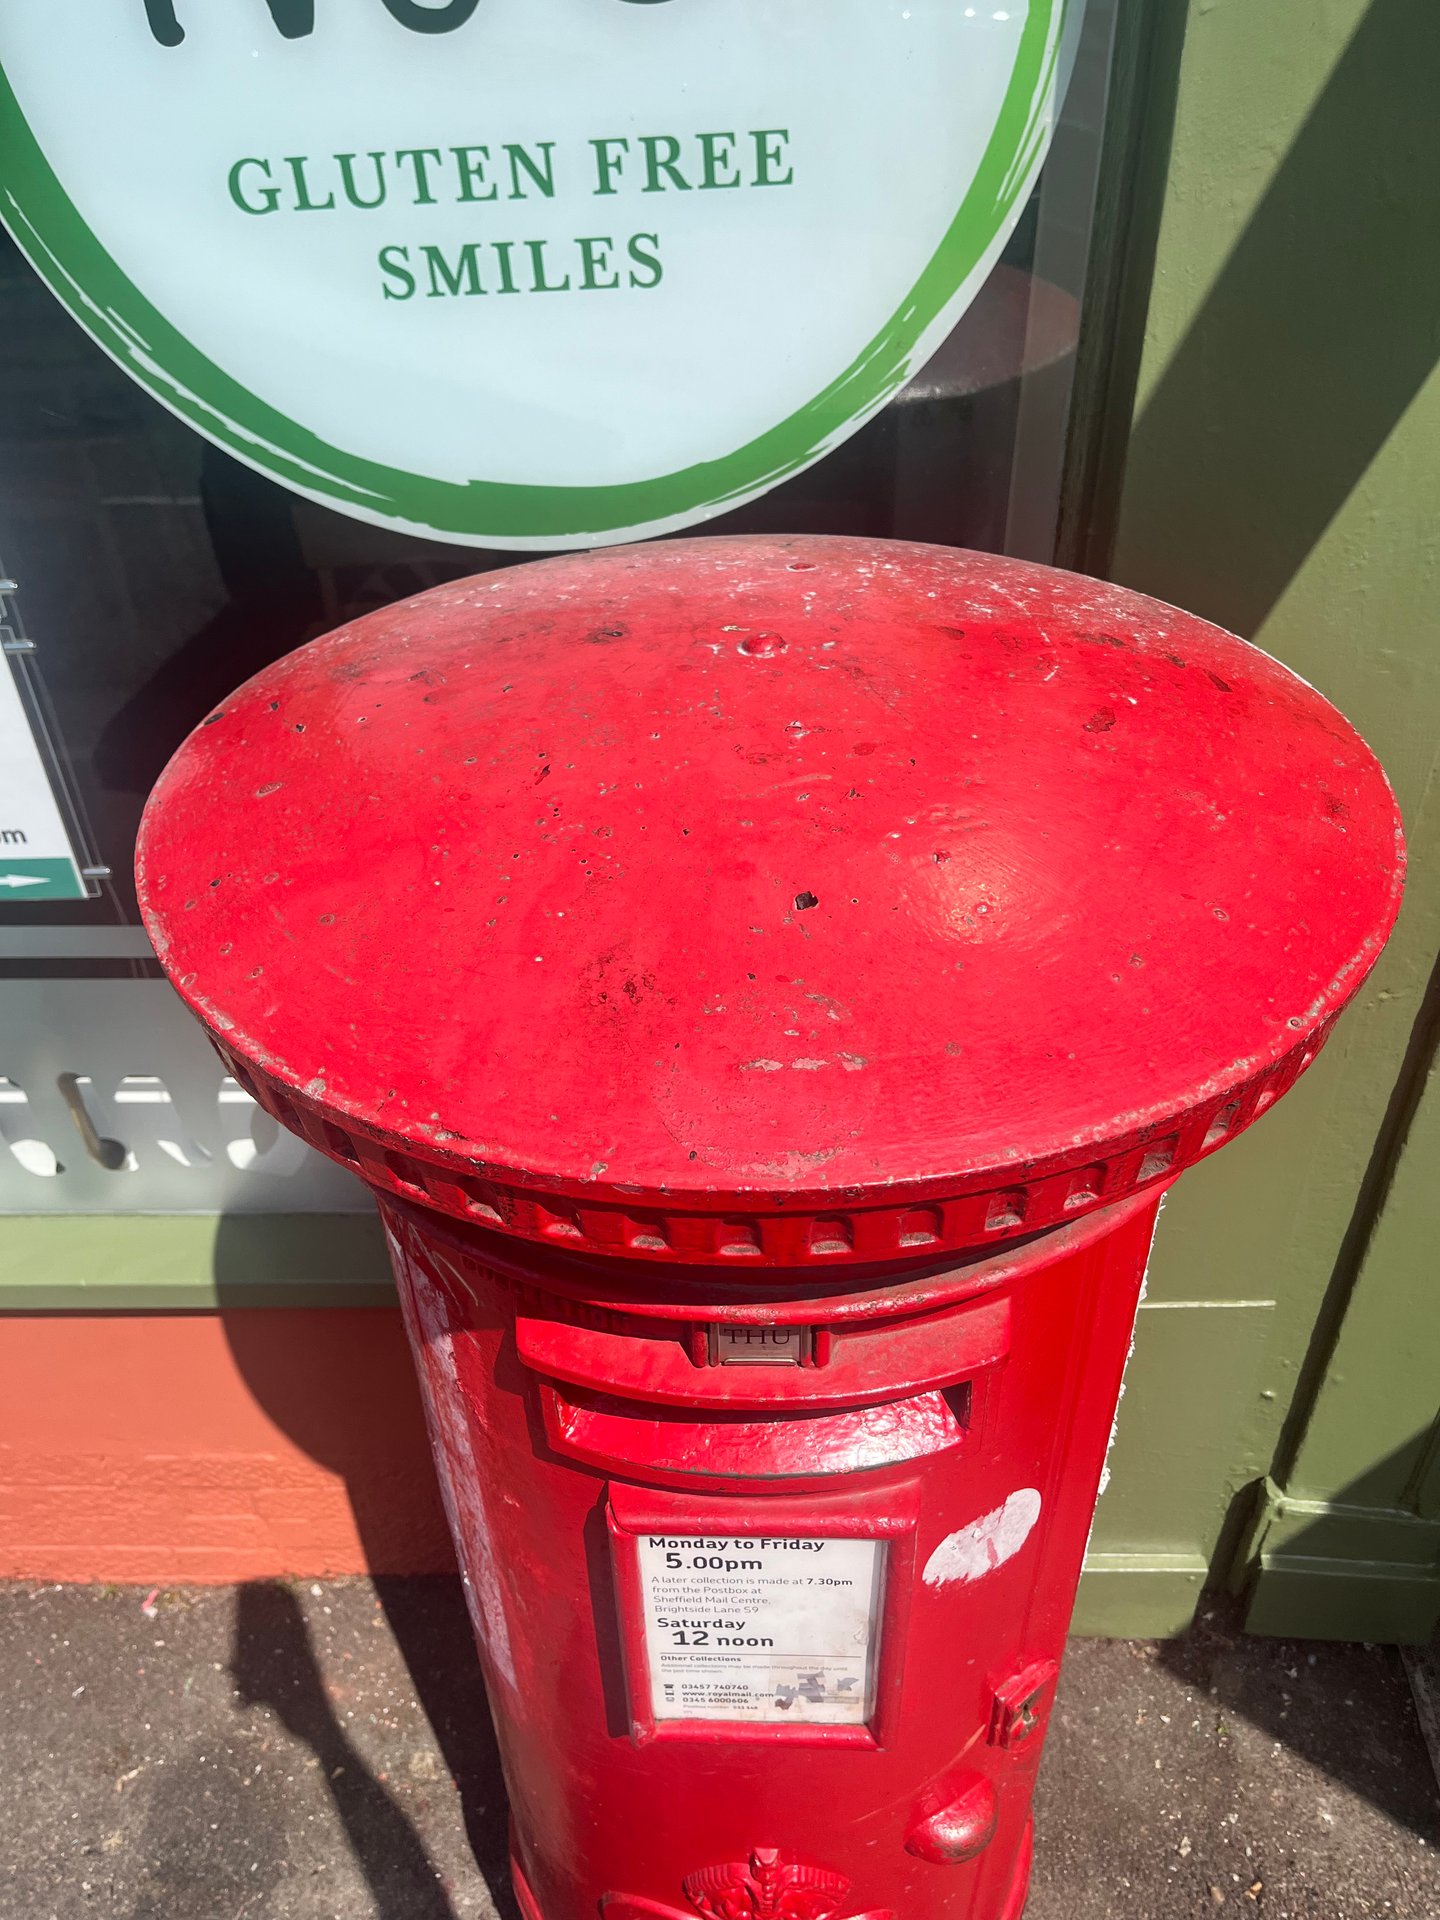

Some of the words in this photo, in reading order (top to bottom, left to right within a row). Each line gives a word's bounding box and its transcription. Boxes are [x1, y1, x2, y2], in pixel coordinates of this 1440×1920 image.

[227, 141, 556, 216] GLUTEN
[587, 129, 795, 196] FREE
[377, 232, 664, 301] SMILES
[723, 1328, 792, 1345] THU
[648, 1537, 729, 1551] Monday
[733, 1539, 754, 1549] to
[760, 1538, 825, 1552] Friday
[665, 1552, 763, 1572] 5.00pm
[651, 1576, 660, 1584] A
[661, 1576, 689, 1584] later
[690, 1576, 743, 1585] collection
[746, 1577, 755, 1585] is
[806, 1578, 853, 1586] 7.30pm
[682, 1586, 701, 1594] the
[703, 1586, 748, 1594] Postbox
[653, 1595, 702, 1603] Sheffield
[705, 1596, 728, 1604] Mail
[730, 1596, 772, 1605] Centre,
[654, 1605, 711, 1614] Brightside
[743, 1606, 759, 1614] S9
[657, 1617, 746, 1630] Saturday
[672, 1630, 709, 1646] 12
[716, 1637, 774, 1647] noon
[682, 1690, 775, 1698] www.royalmail.com
